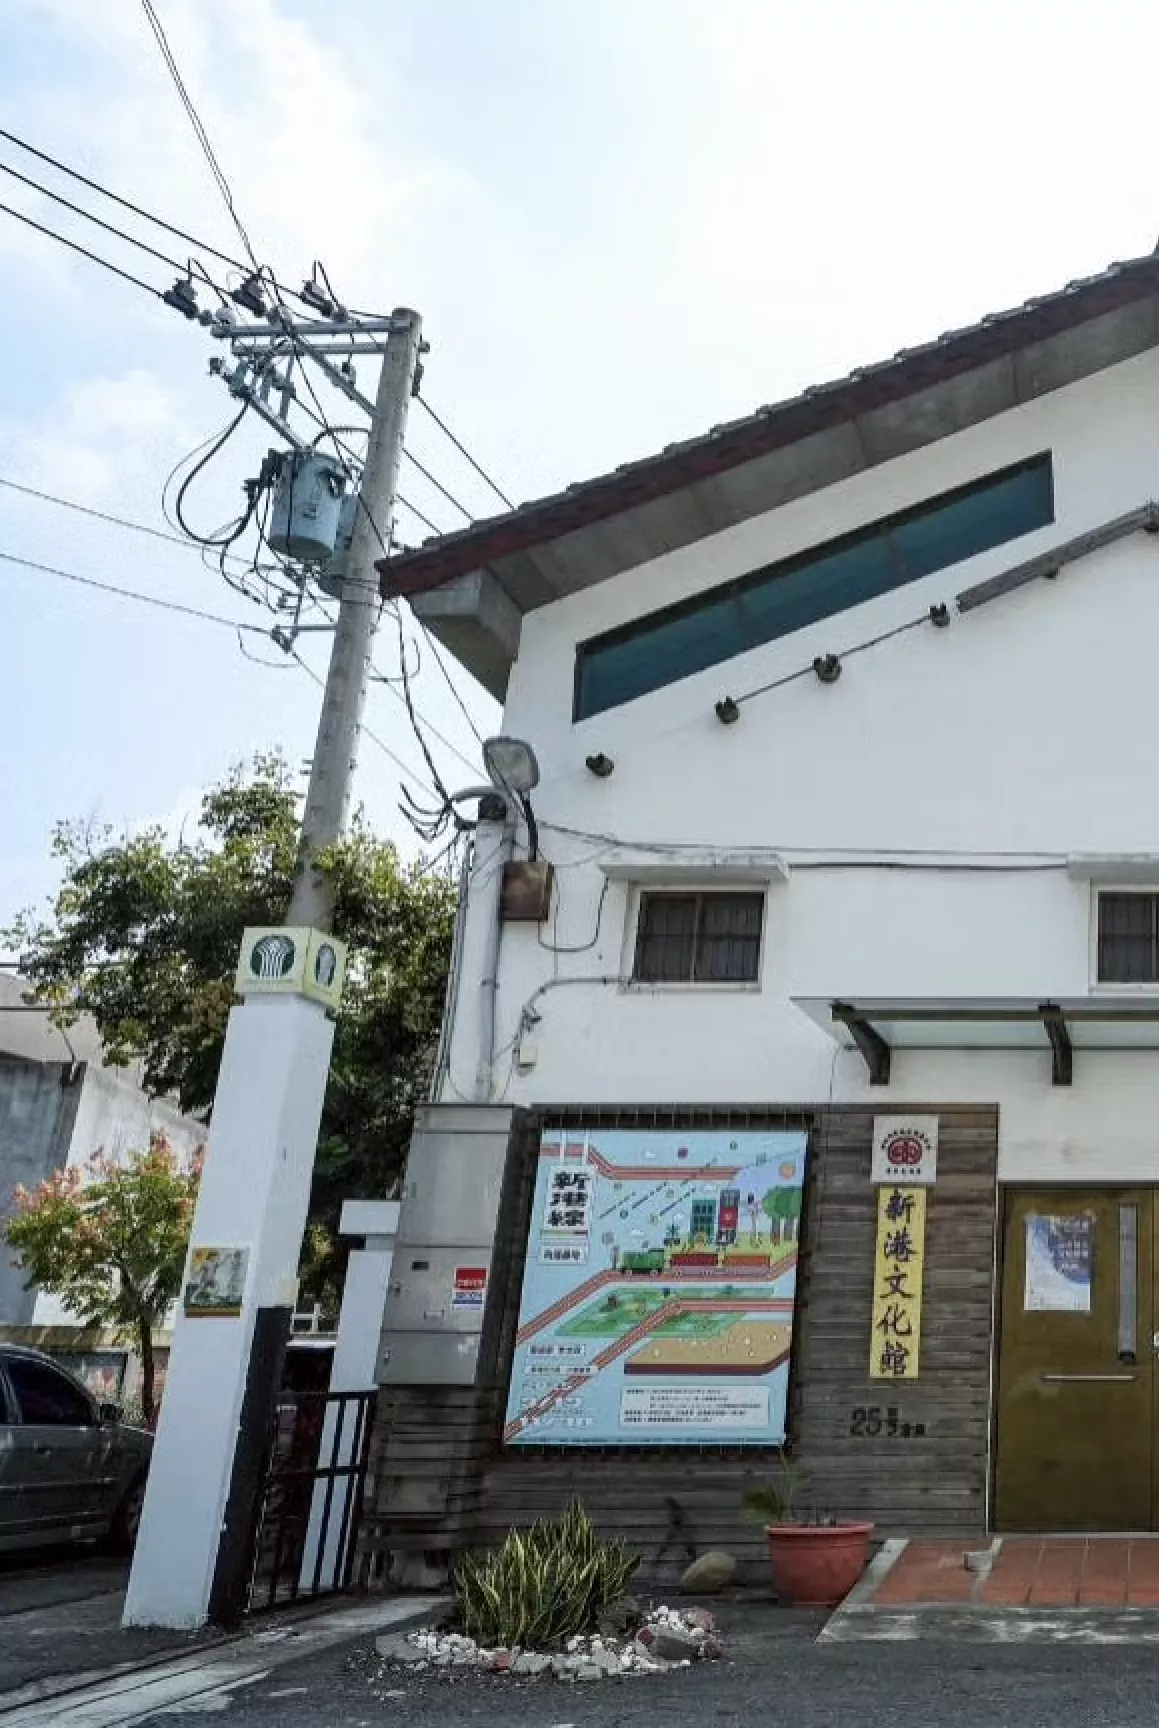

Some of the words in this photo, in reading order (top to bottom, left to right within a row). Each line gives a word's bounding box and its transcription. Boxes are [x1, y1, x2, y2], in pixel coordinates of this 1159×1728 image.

[876, 1189, 918, 1376] 新港文化館
